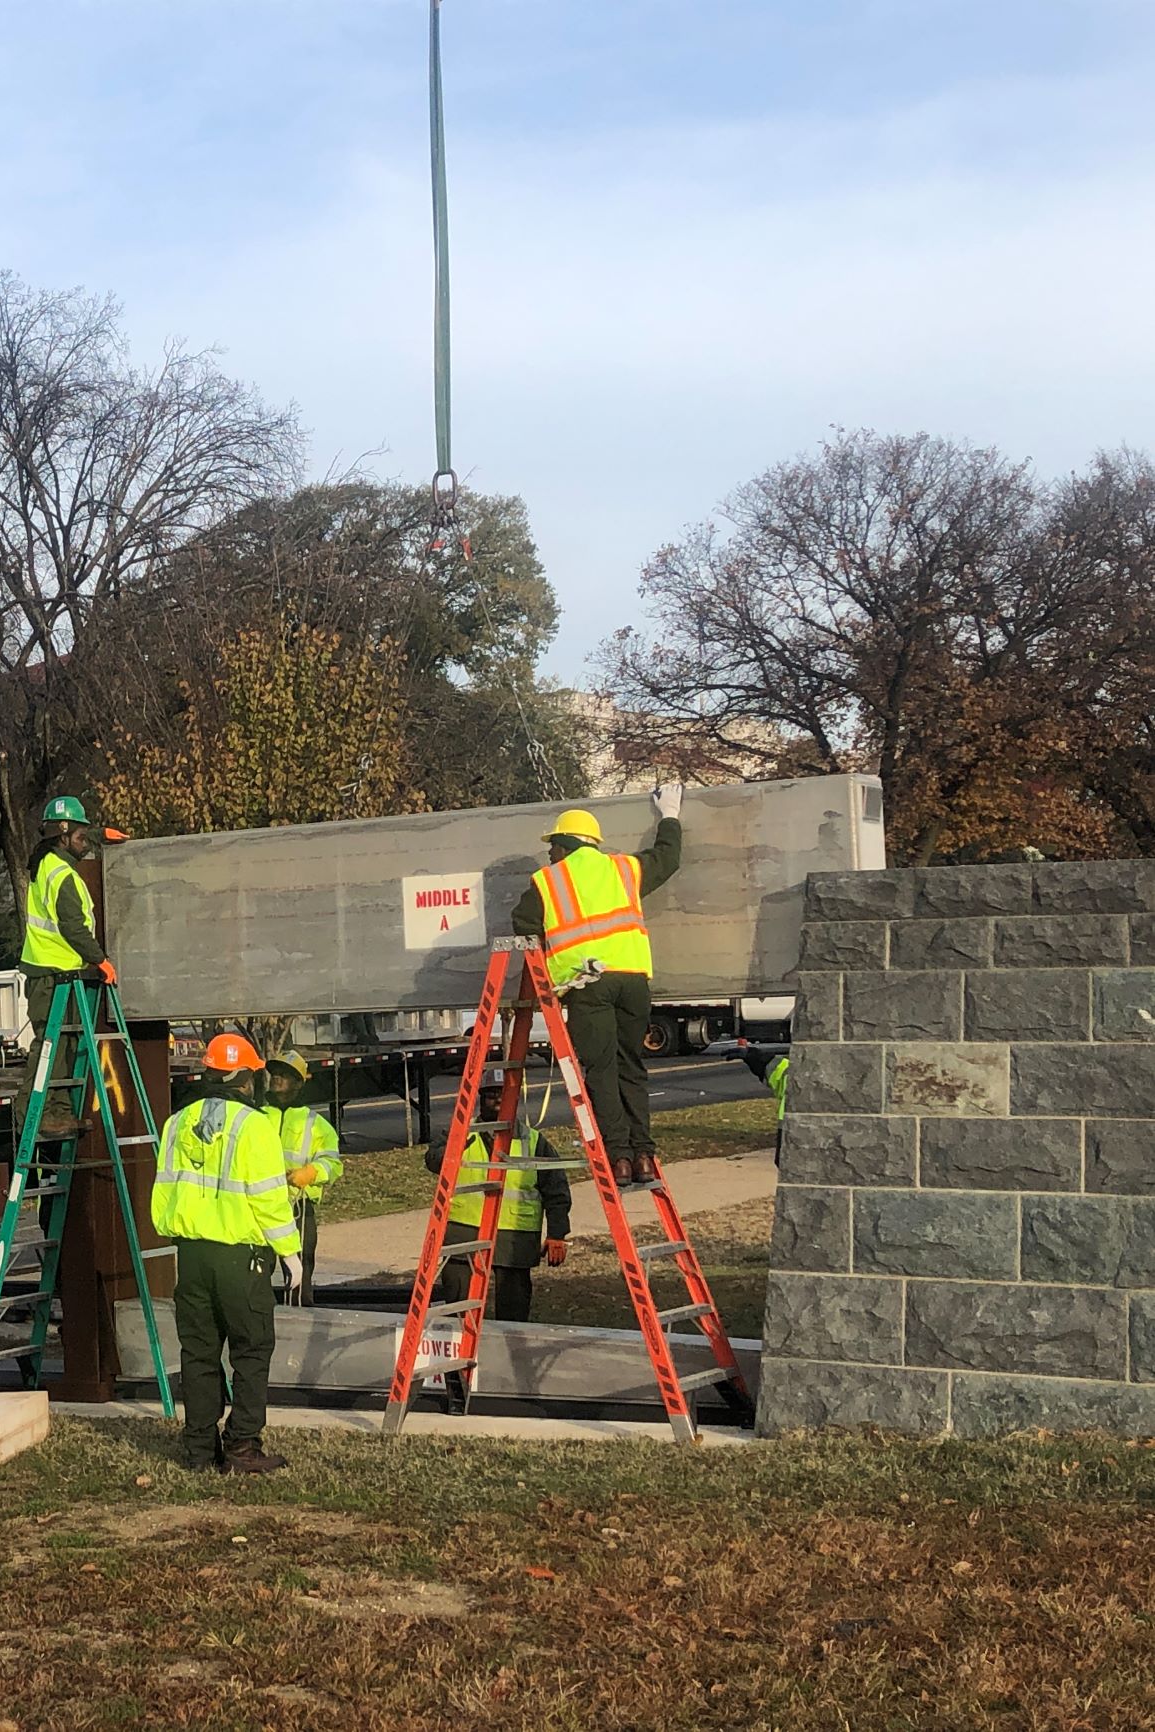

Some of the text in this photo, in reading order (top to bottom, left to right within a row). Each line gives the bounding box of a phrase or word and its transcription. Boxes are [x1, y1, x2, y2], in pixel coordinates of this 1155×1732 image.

[415, 887, 471, 909] MIDDLE
[439, 914, 450, 931] A
[92, 1040, 126, 1114] A
[417, 1339, 461, 1358] OWER
